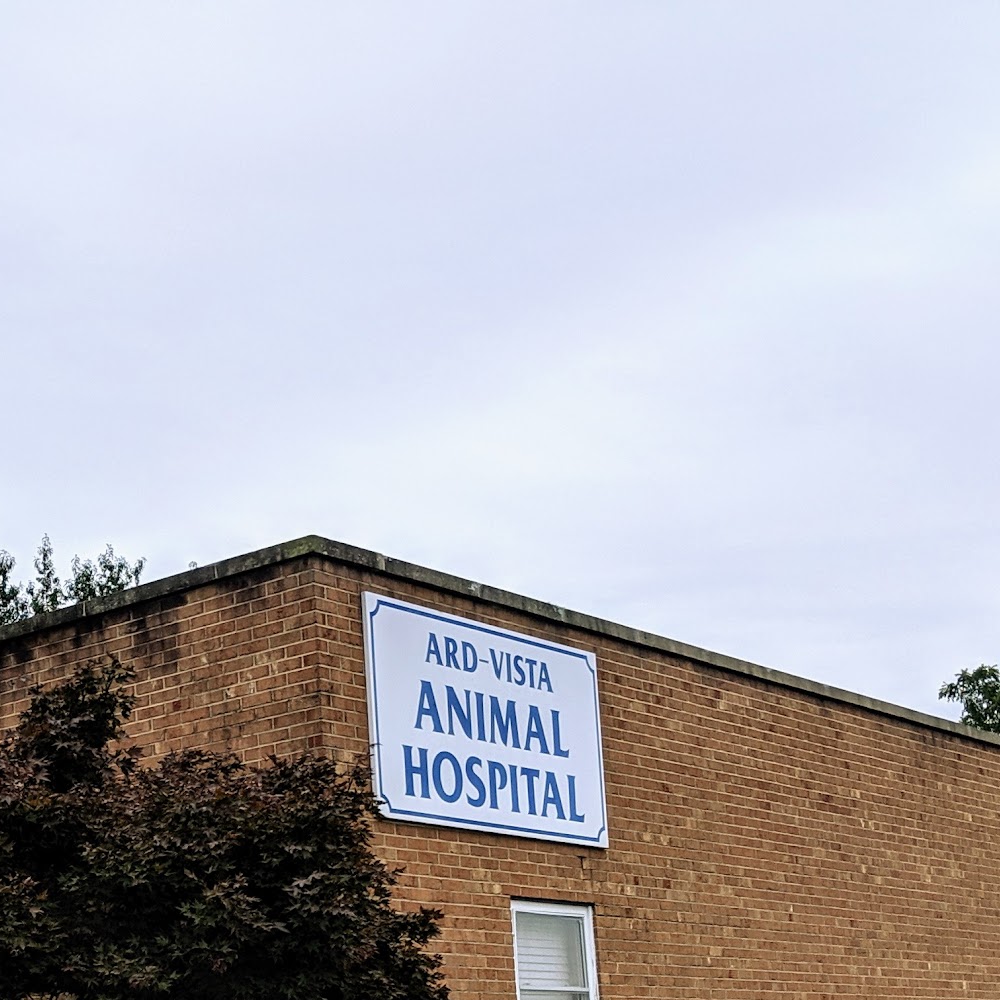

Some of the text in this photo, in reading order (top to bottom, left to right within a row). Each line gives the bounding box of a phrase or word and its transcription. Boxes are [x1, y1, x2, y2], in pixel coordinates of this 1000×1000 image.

[425, 632, 554, 693] ARD-VISTA
[414, 680, 570, 758] ANIMAL
[402, 744, 586, 823] HOSPITAL
